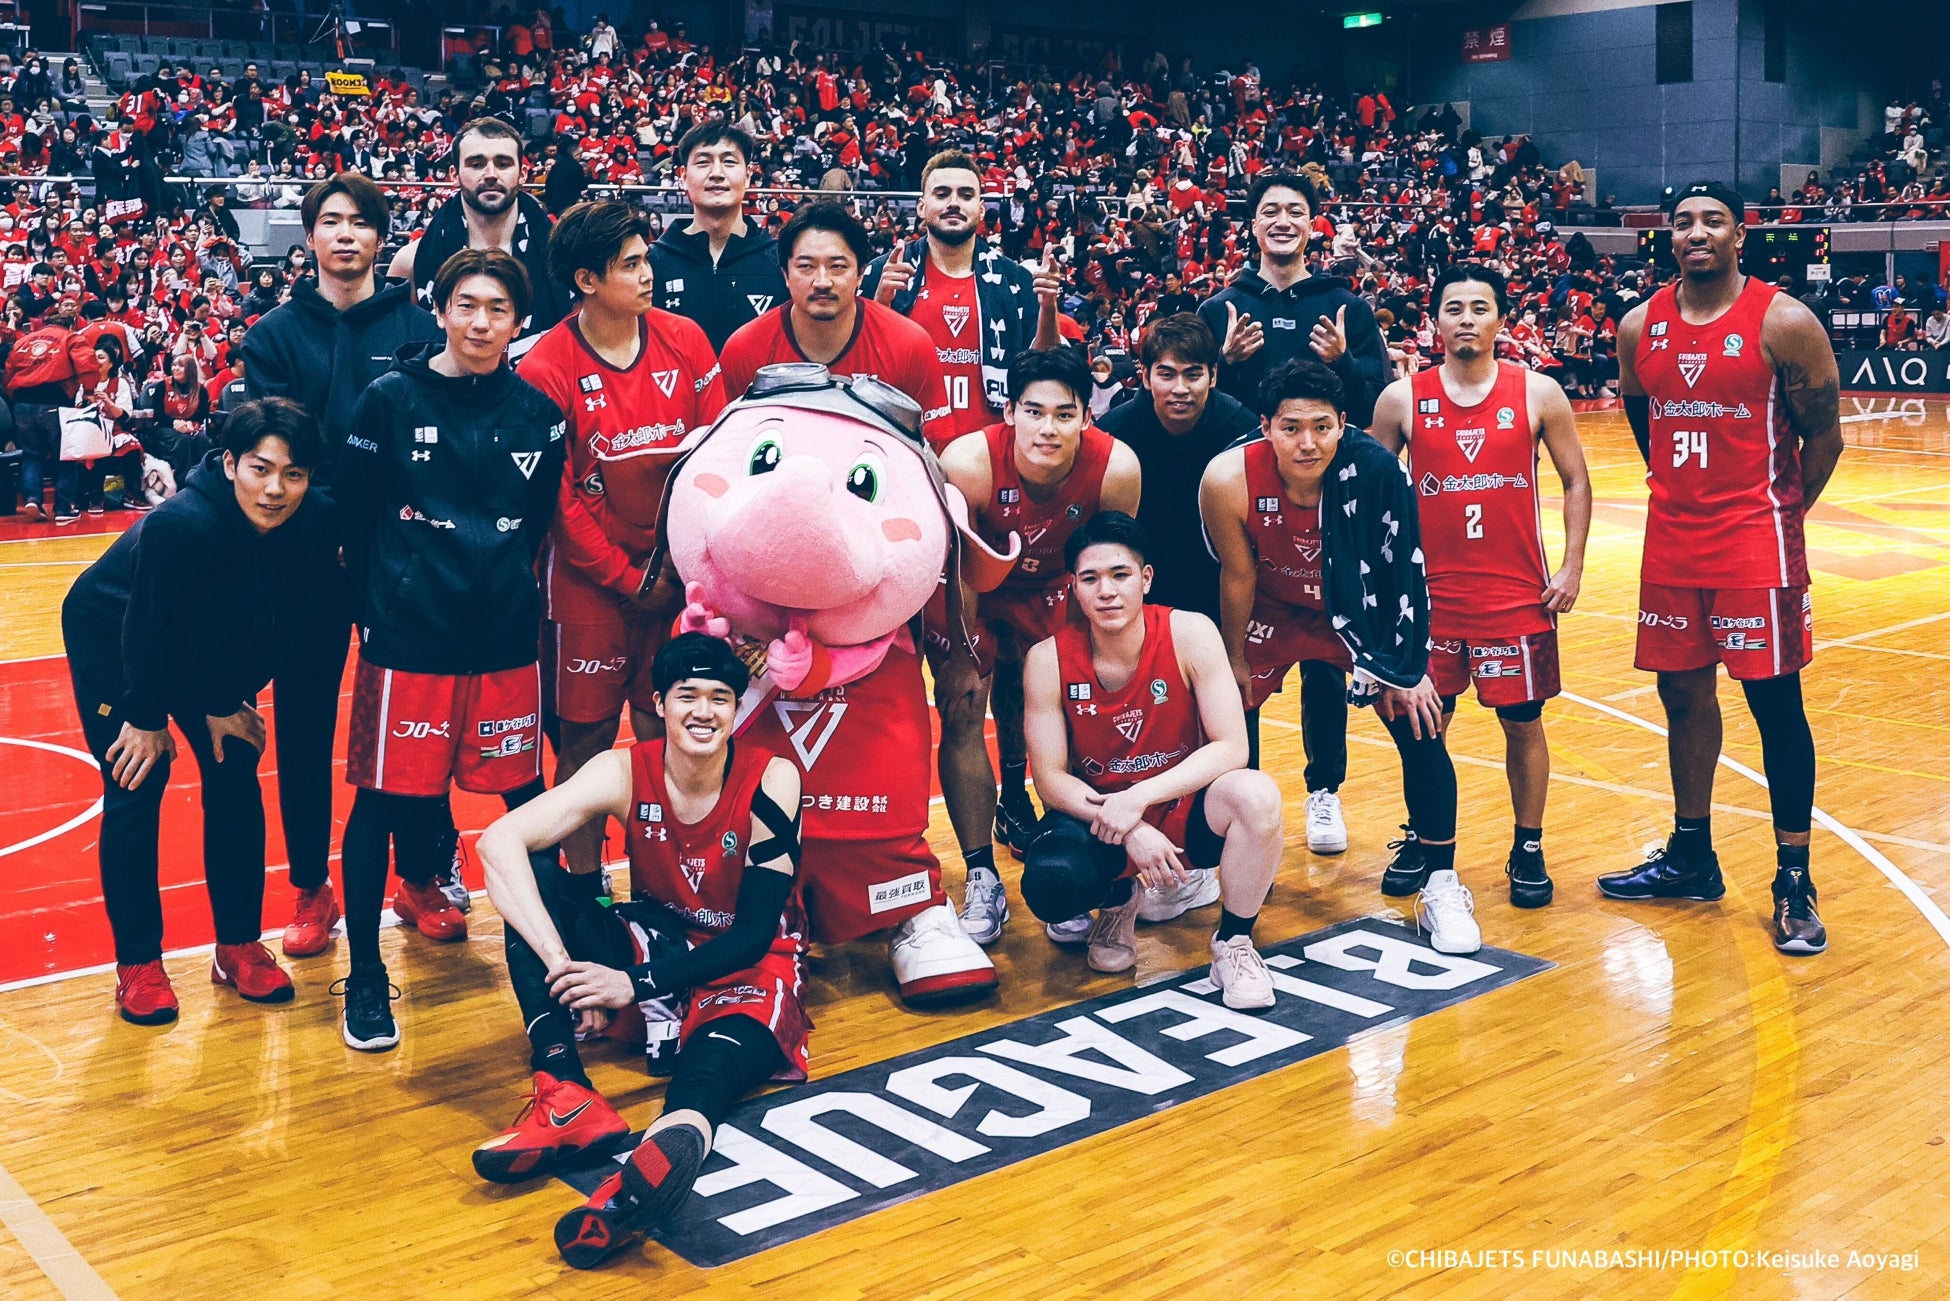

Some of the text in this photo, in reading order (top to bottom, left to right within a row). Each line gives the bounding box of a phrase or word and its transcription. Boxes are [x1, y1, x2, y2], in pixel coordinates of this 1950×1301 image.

[1664, 400, 1752, 419] 金太郎ホーム
[347, 434, 378, 453] ANKER
[611, 418, 686, 451] 金太郎ホーム
[1672, 431, 1708, 468] 34
[1443, 472, 1529, 492] 金太郎ホーム
[1465, 504, 1484, 539] 2
[1246, 620, 1274, 639] IXI
